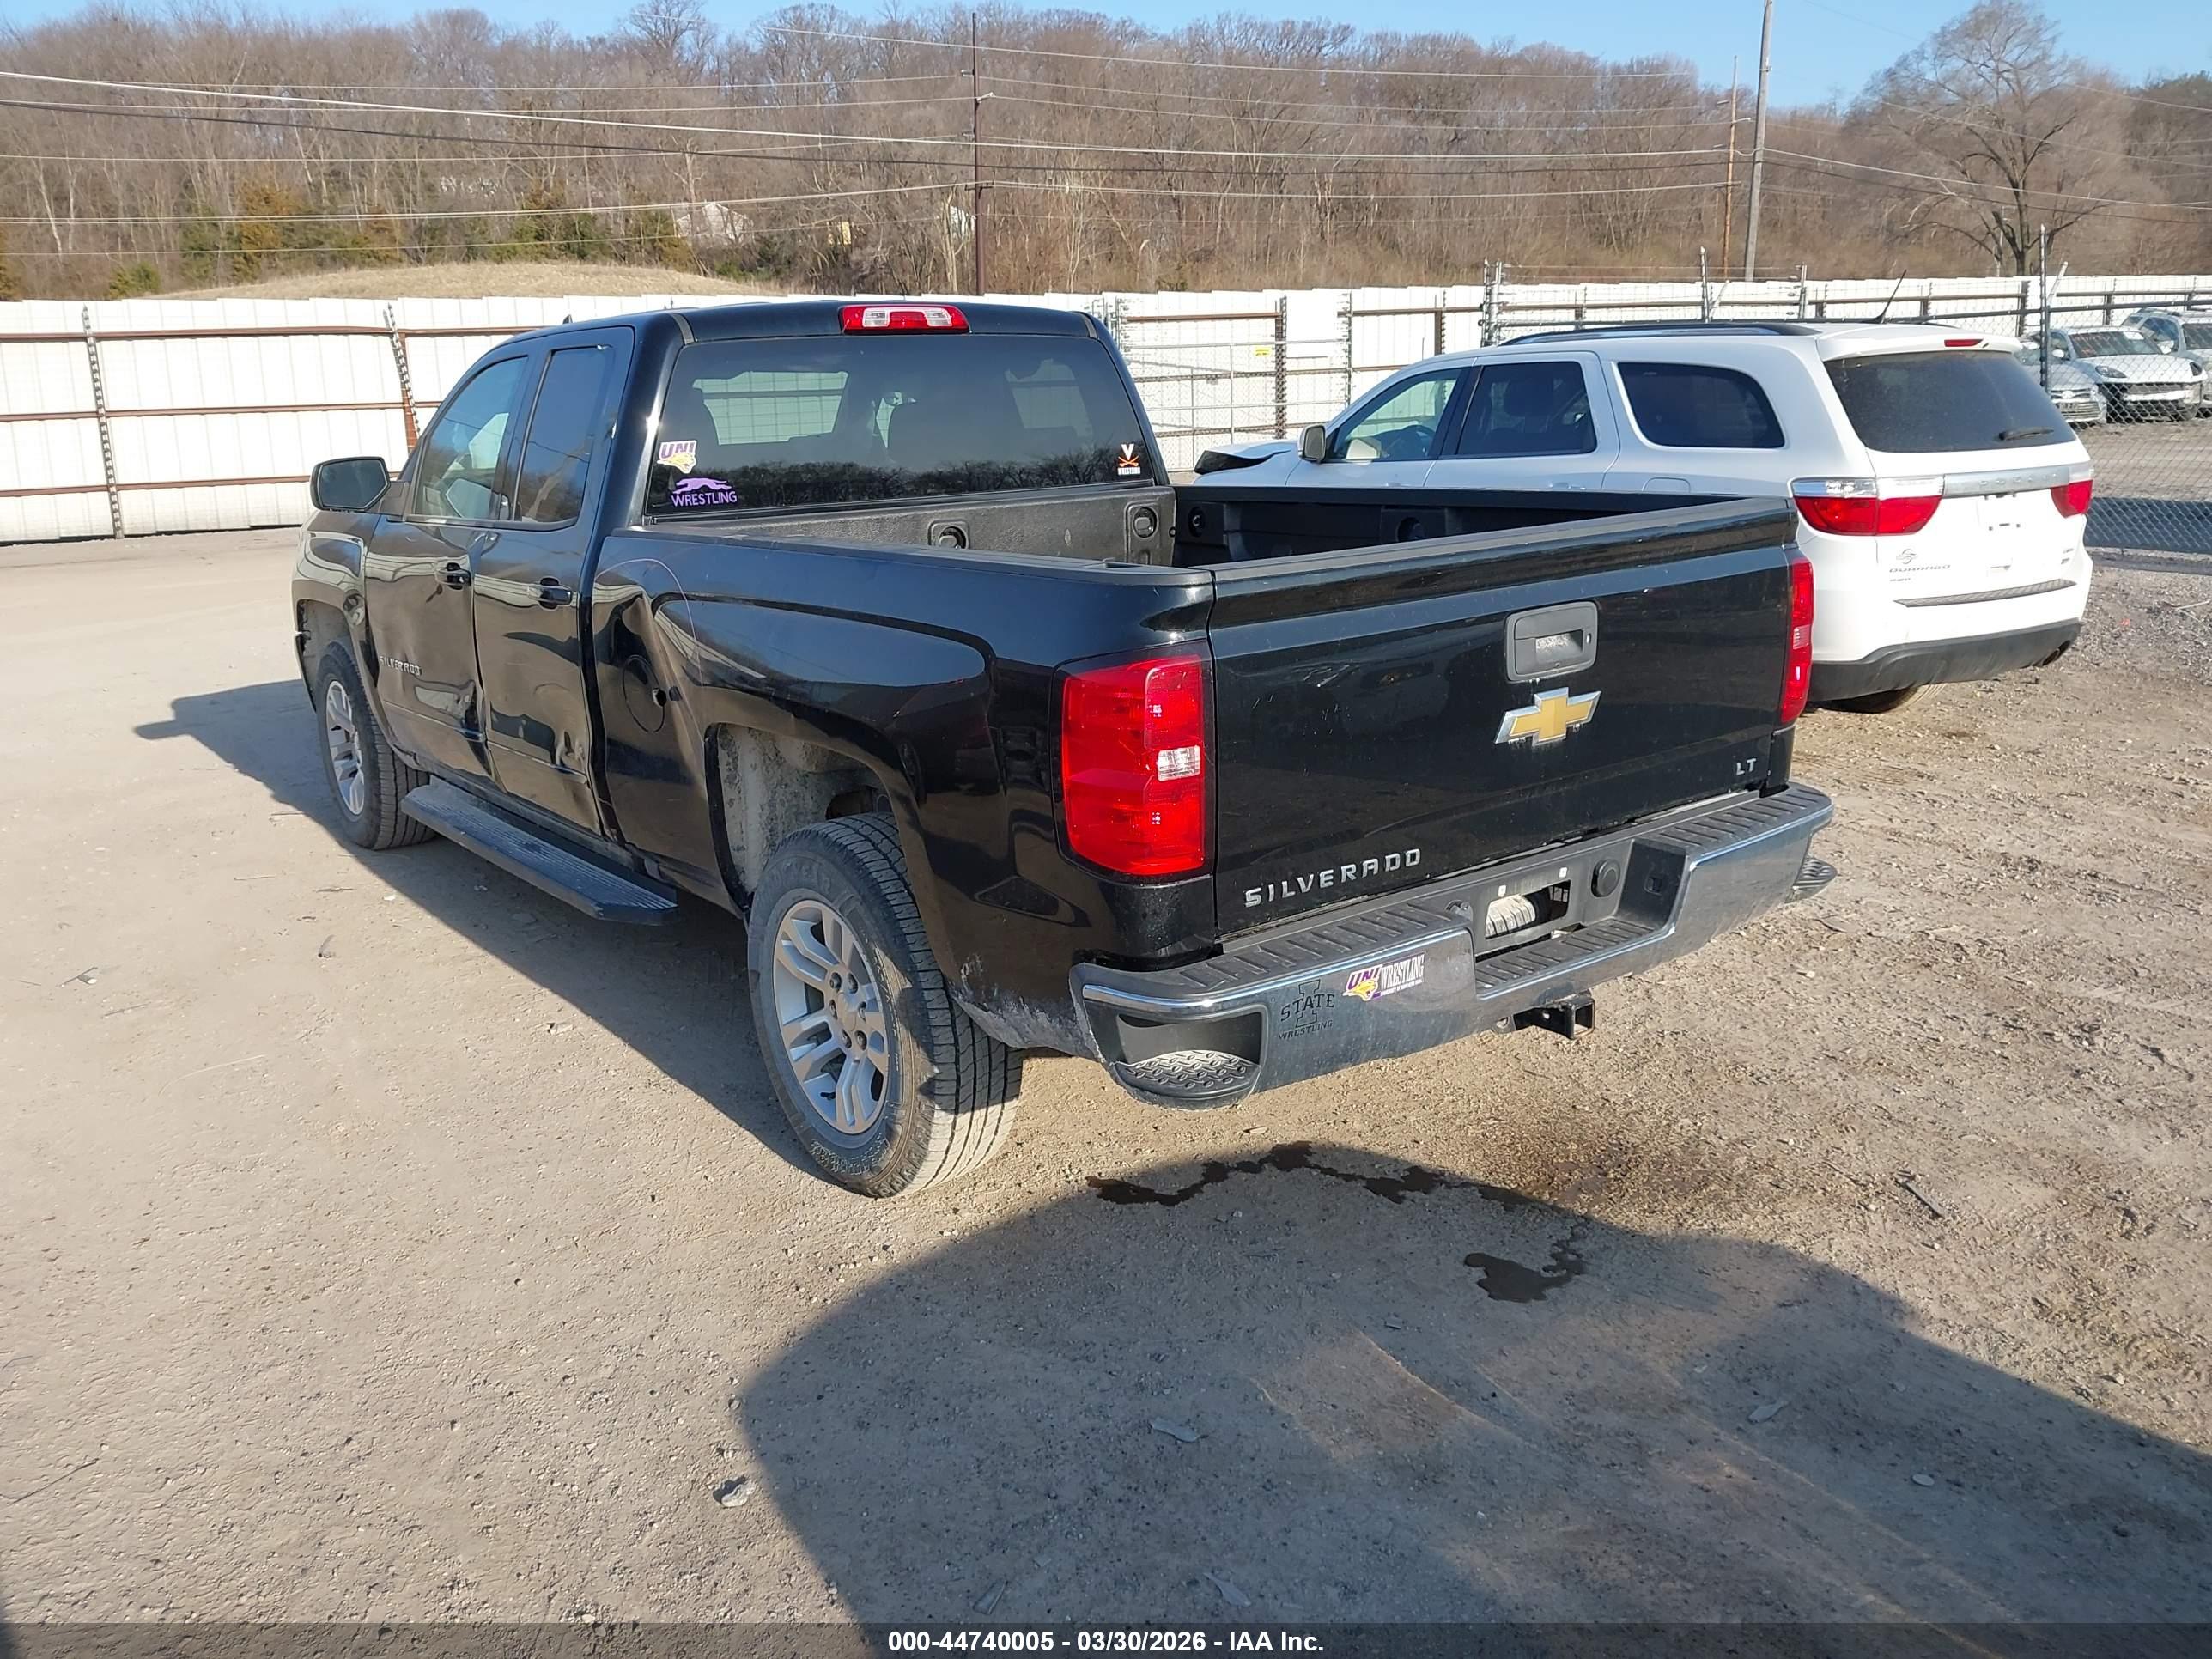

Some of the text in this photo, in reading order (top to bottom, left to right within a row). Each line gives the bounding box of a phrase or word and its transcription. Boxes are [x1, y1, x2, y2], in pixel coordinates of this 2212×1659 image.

[660, 441, 696, 459] UNI
[1121, 443, 1134, 461] V
[671, 490, 738, 507] WRESTLING
[380, 655, 421, 676] SILVERADO
[1736, 757, 1757, 775] LT
[1244, 848, 1422, 908] SILVERADO
[1347, 965, 1382, 991] UNI
[1380, 953, 1425, 991] WRESTLING
[1279, 993, 1335, 1023] STATE
[1278, 1019, 1334, 1040] WRESTLING
